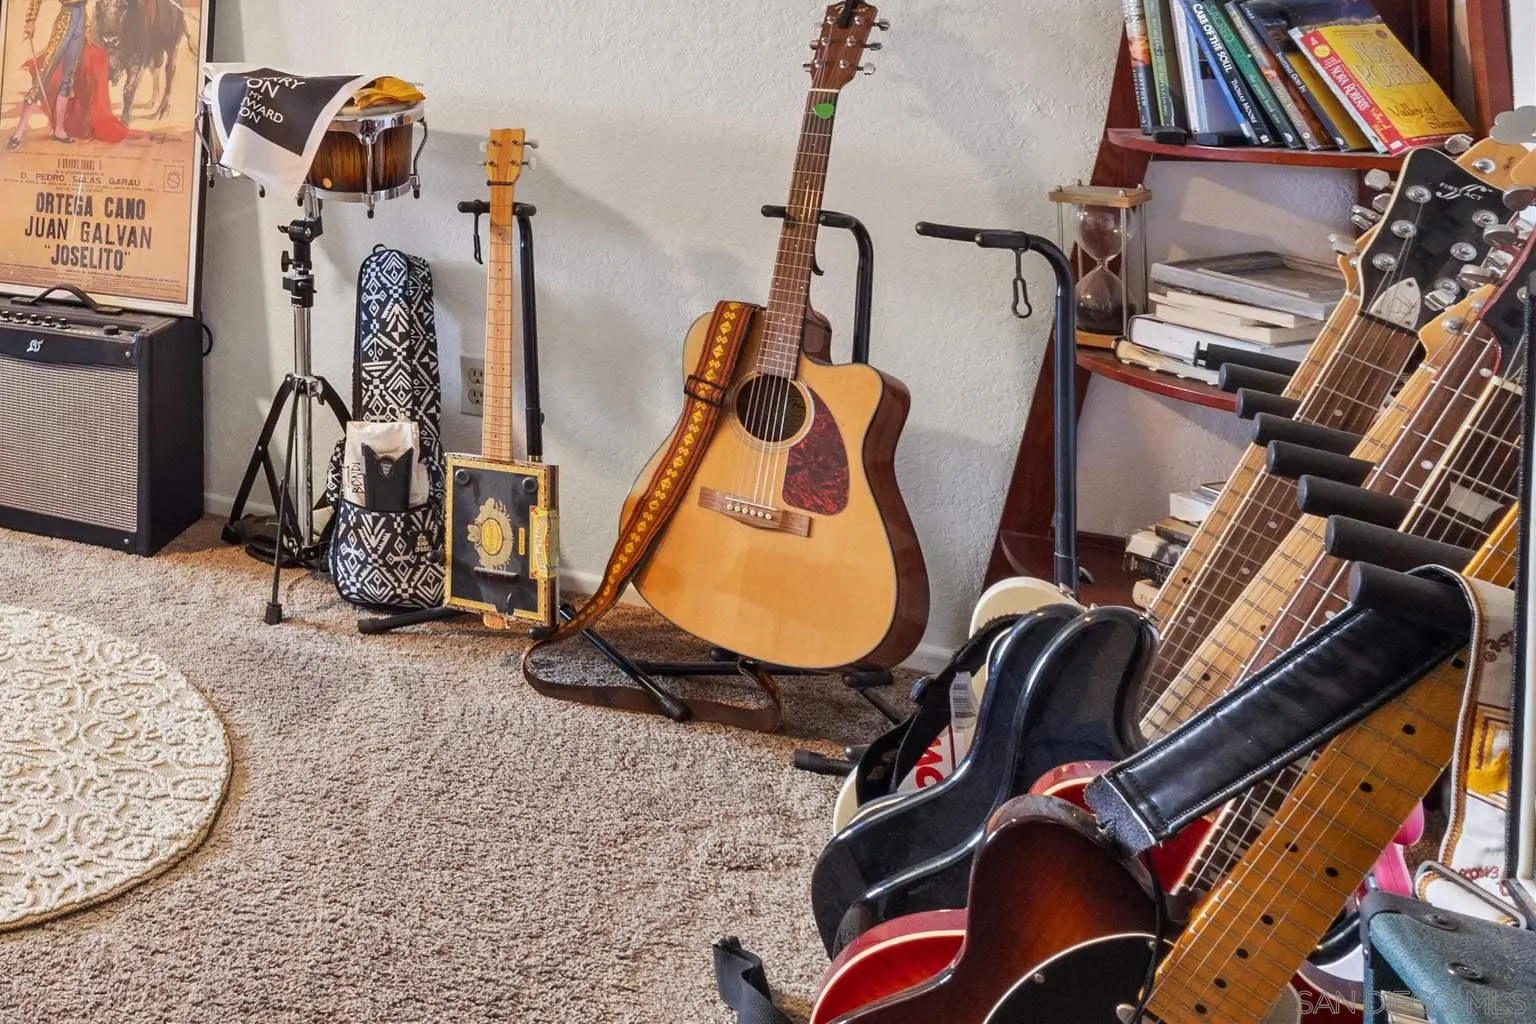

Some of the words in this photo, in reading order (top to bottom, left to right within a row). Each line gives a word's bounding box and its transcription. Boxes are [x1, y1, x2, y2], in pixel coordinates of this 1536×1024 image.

[1192, 2, 1210, 26] CARE
[1206, 3, 1235, 43] SACRED
[1203, 24, 1216, 38] OF
[1209, 33, 1224, 55] THE
[1217, 51, 1235, 74] SOUL
[247, 78, 280, 98] ON
[249, 91, 263, 101] MY
[1331, 64, 1350, 87] NORA
[1344, 82, 1370, 111] ROBERTS
[1231, 78, 1246, 102] THOMAS
[1241, 98, 1258, 123] MOORE
[1386, 103, 1423, 118] Valley
[35, 172, 65, 182] PEDRO
[72, 175, 102, 185] SALAS
[108, 178, 141, 187] GARAU
[36, 192, 94, 218] ORTEGA
[104, 196, 146, 221] CANO
[1464, 192, 1483, 201] ACT
[24, 216, 68, 241] JUAN
[80, 222, 153, 250] GALVAN
[351, 461, 366, 494] BONDI
